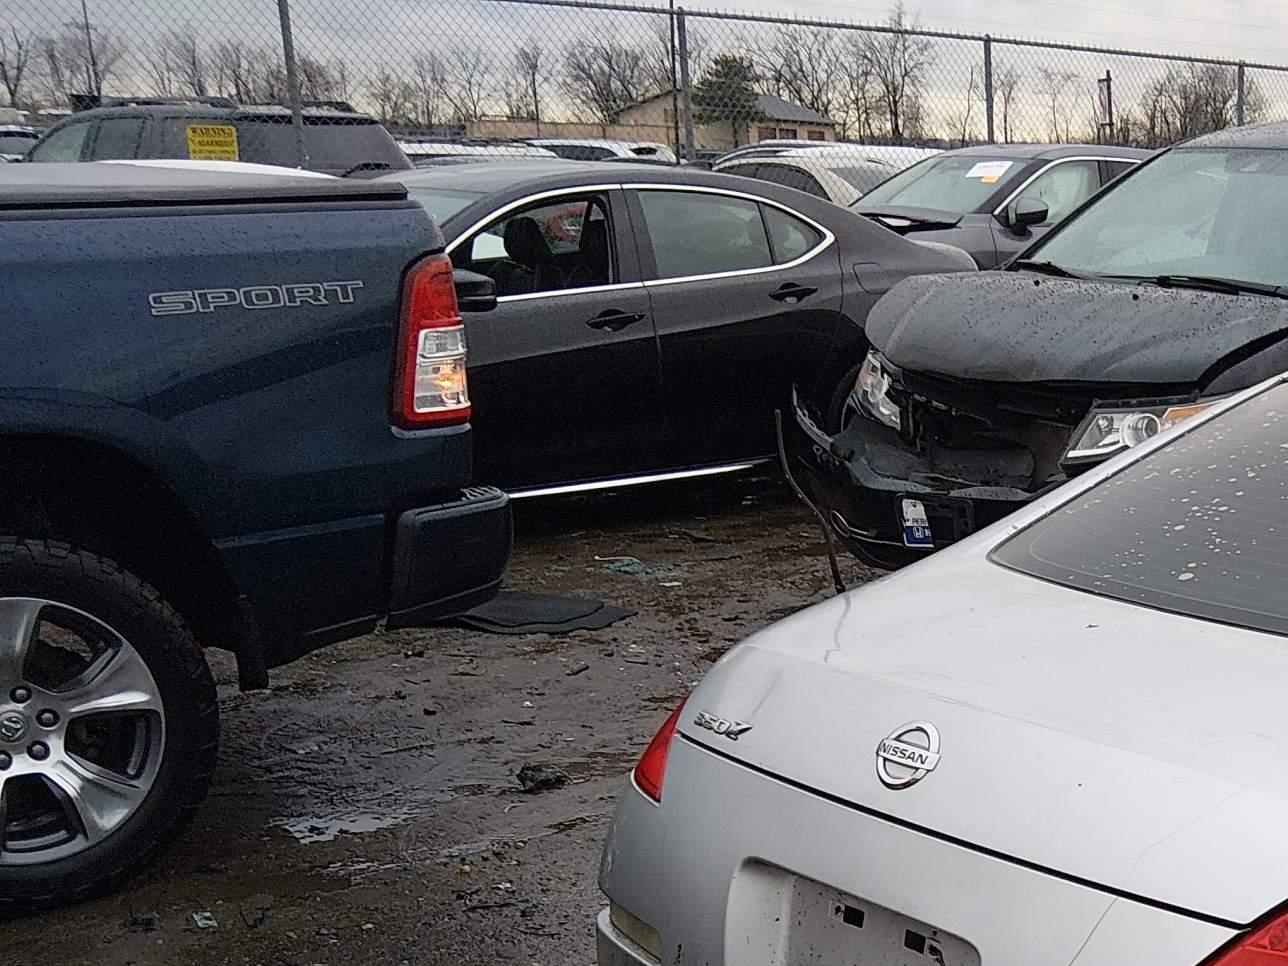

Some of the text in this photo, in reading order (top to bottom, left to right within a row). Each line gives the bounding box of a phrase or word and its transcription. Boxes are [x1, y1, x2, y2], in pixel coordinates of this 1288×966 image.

[149, 281, 364, 316] SPORT
[693, 711, 752, 741] 350Z
[879, 741, 929, 766] NISSAN
